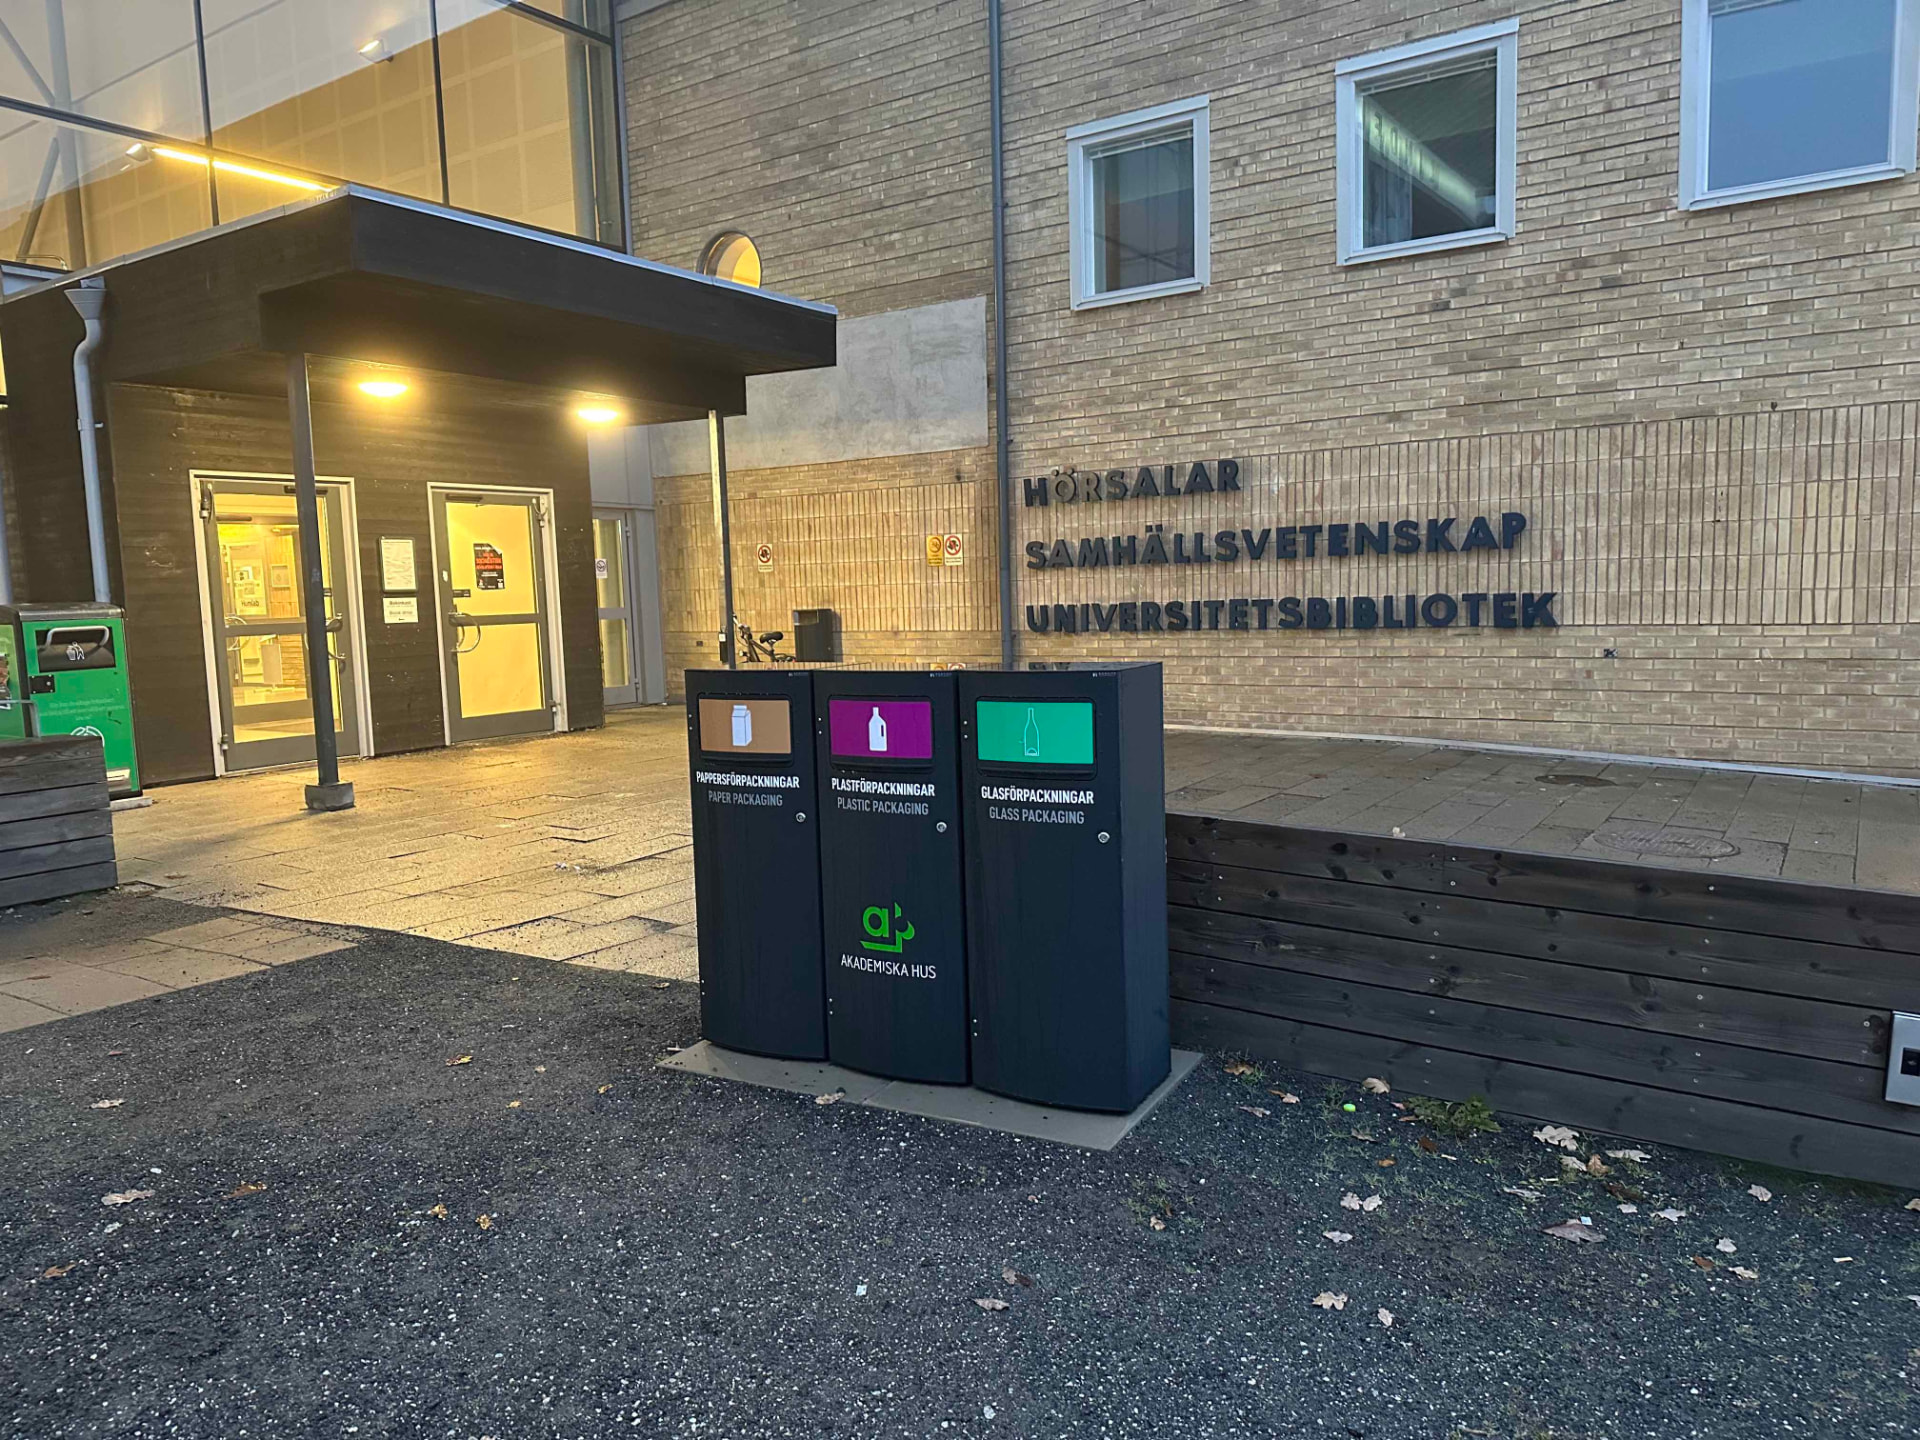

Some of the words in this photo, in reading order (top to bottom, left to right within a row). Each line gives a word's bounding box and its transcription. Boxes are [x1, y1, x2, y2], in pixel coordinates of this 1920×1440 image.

[1023, 460, 1241, 507] HÖRSALAR
[1025, 512, 1527, 570] SAMHÄLLSVETENSKAP
[1026, 592, 1559, 634] UNIVERSITETSBIBLIOTEK
[696, 771, 800, 788] PAPPERSFÖRPACKNINGAR
[831, 777, 936, 797] PLASTFÖRPACKNINGAR
[708, 790, 732, 804] PAPER
[732, 792, 783, 807] PACKAGING
[981, 785, 1095, 804] GLASFÖRPACKNINGAR
[837, 797, 871, 812] PLASTIC
[872, 800, 929, 815] PACKAGING
[989, 806, 1020, 821] GLASS
[1022, 808, 1085, 824] PACKAGING
[840, 953, 909, 977] AKADEMISKA
[911, 964, 937, 979] HUS
